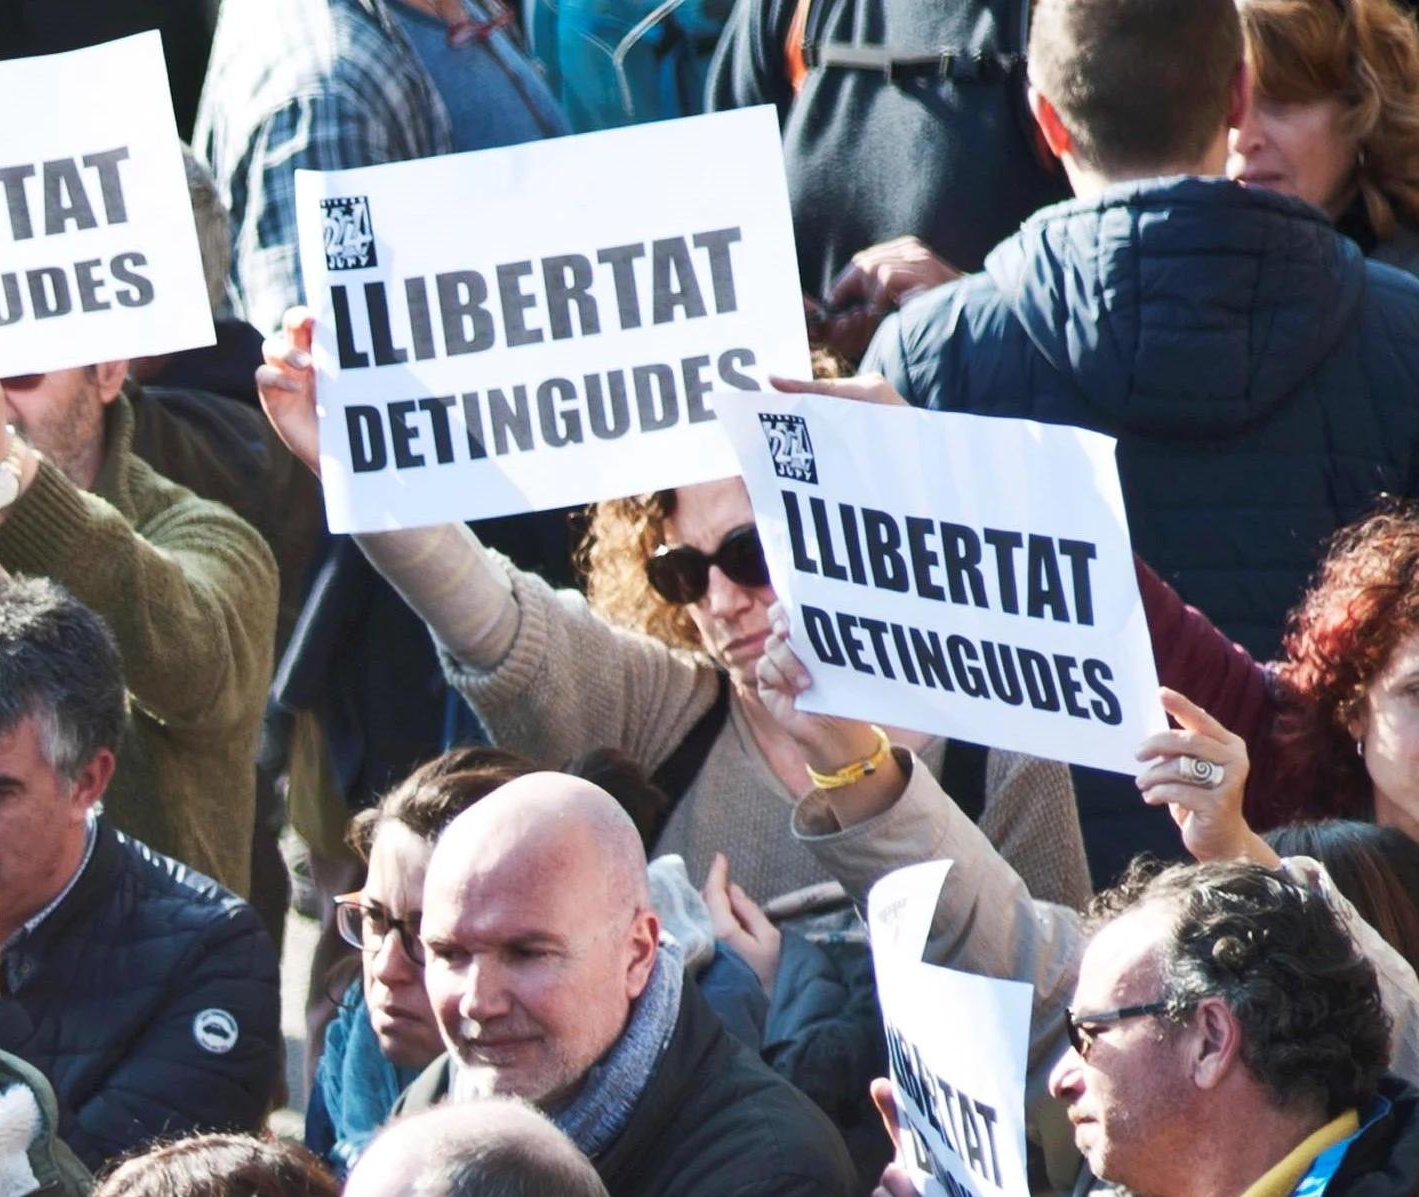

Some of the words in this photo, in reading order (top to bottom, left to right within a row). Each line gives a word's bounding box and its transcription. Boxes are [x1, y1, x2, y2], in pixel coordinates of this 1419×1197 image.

[330, 226, 742, 370] LLIBERTAT
[781, 489, 1098, 627] LLIBERTAT
[800, 604, 1123, 726] DETINGUDES
